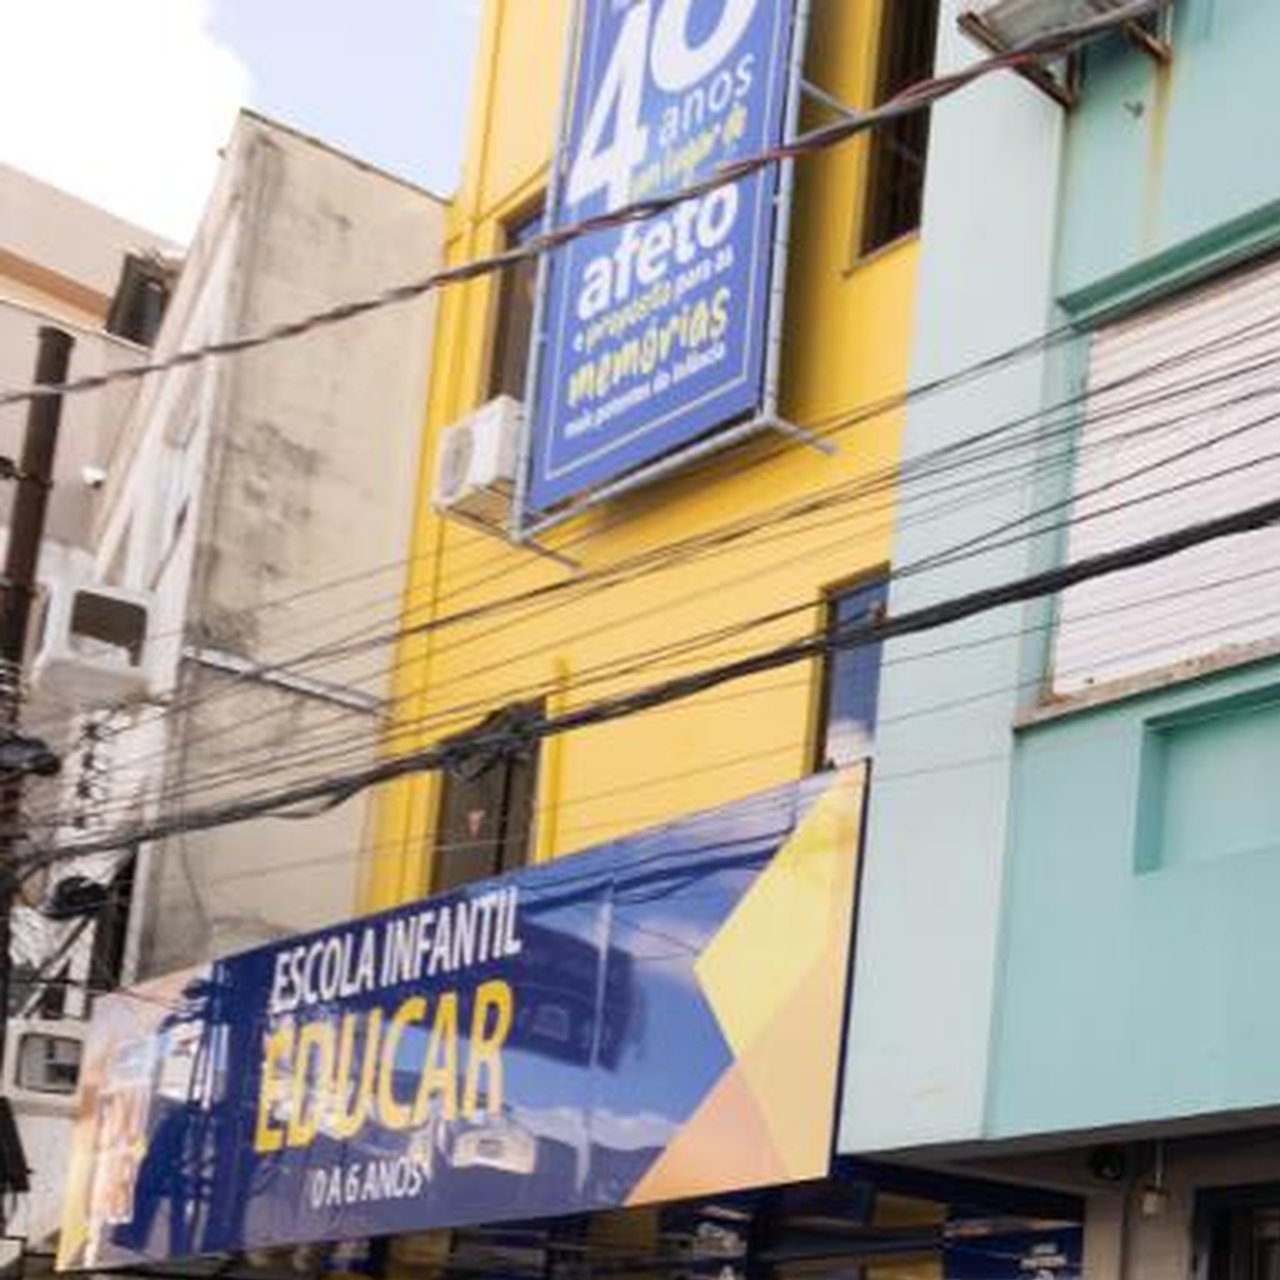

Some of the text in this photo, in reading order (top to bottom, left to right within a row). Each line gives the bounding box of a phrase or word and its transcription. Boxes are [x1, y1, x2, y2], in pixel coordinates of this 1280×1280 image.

[658, 53, 755, 147] anos
[577, 181, 738, 320] afeto
[567, 288, 728, 407] memórias
[268, 886, 521, 1014] ESCOLA INFANTIL
[253, 977, 514, 1154] EDUCAR
[310, 1155, 424, 1209] 0 A 6 ANOS
